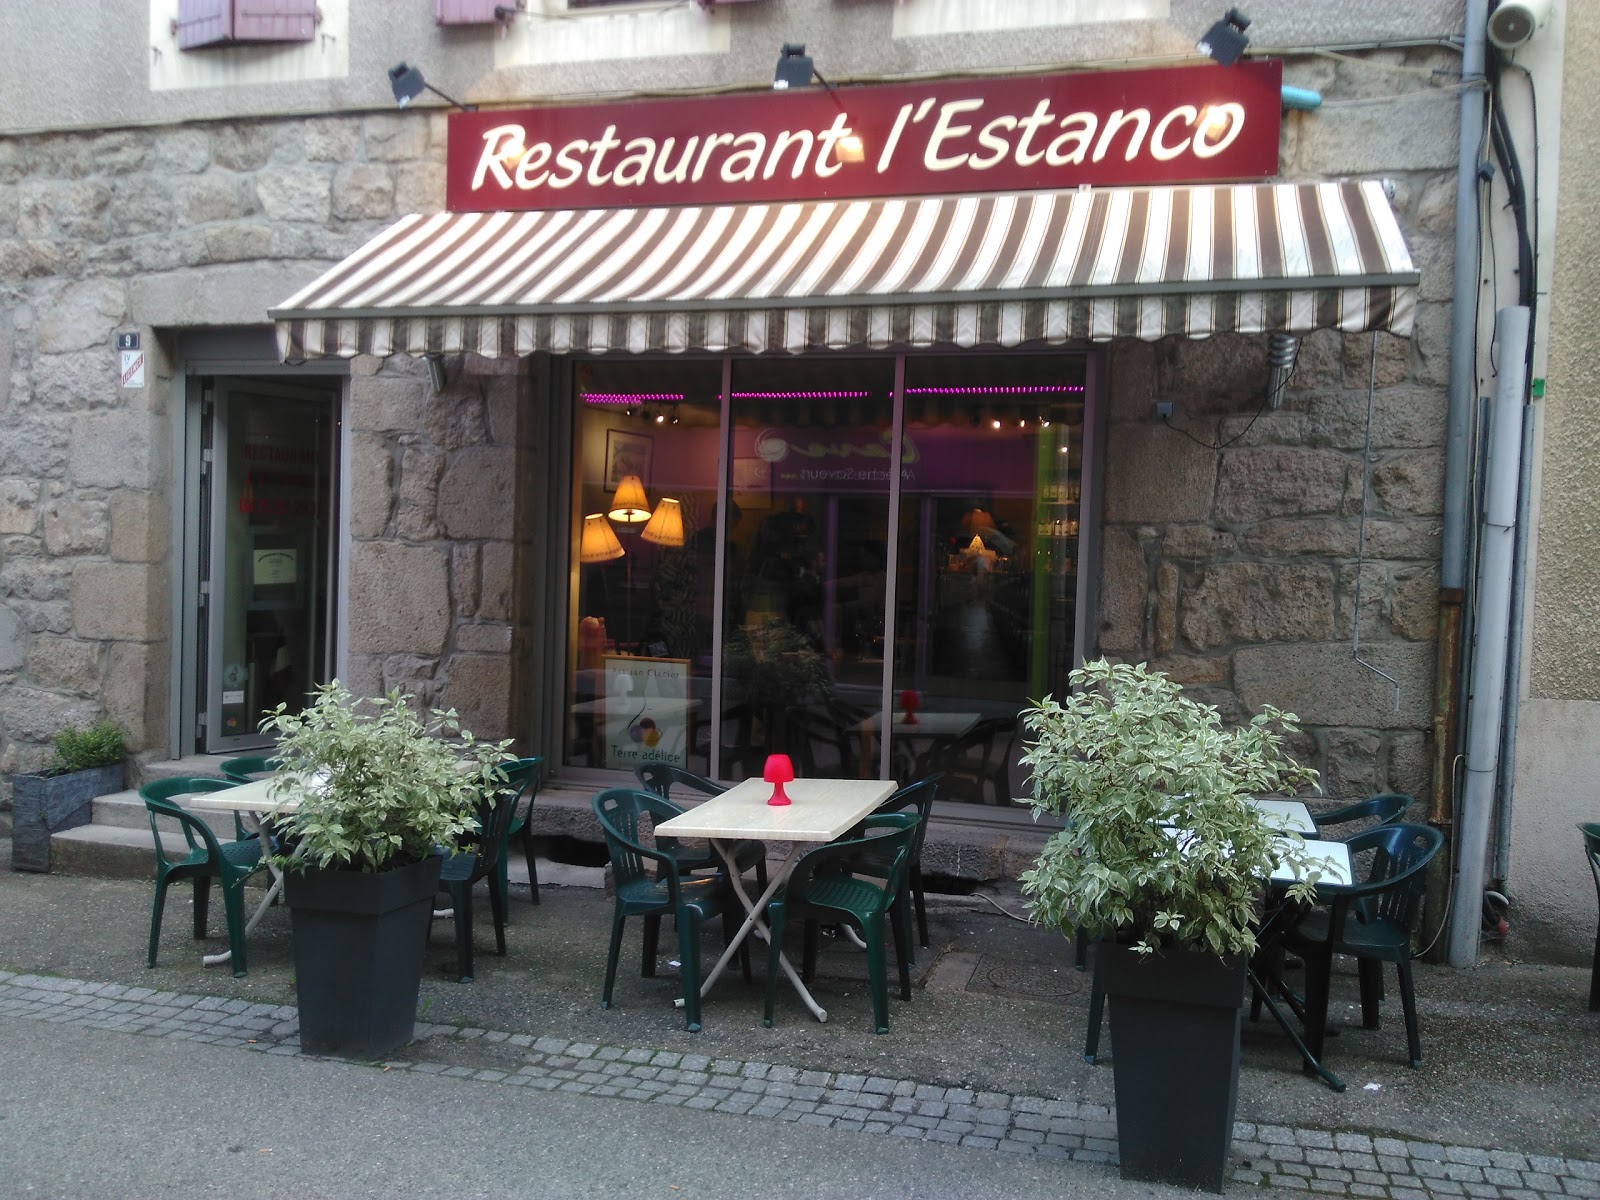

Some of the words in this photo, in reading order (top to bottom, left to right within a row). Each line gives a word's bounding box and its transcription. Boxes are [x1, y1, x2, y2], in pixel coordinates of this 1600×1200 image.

[471, 111, 853, 192] Restaurant
[876, 97, 1246, 174] l'Estanco
[125, 334, 131, 347] 9
[612, 744, 638, 759] Terre
[641, 749, 680, 763] adélice
